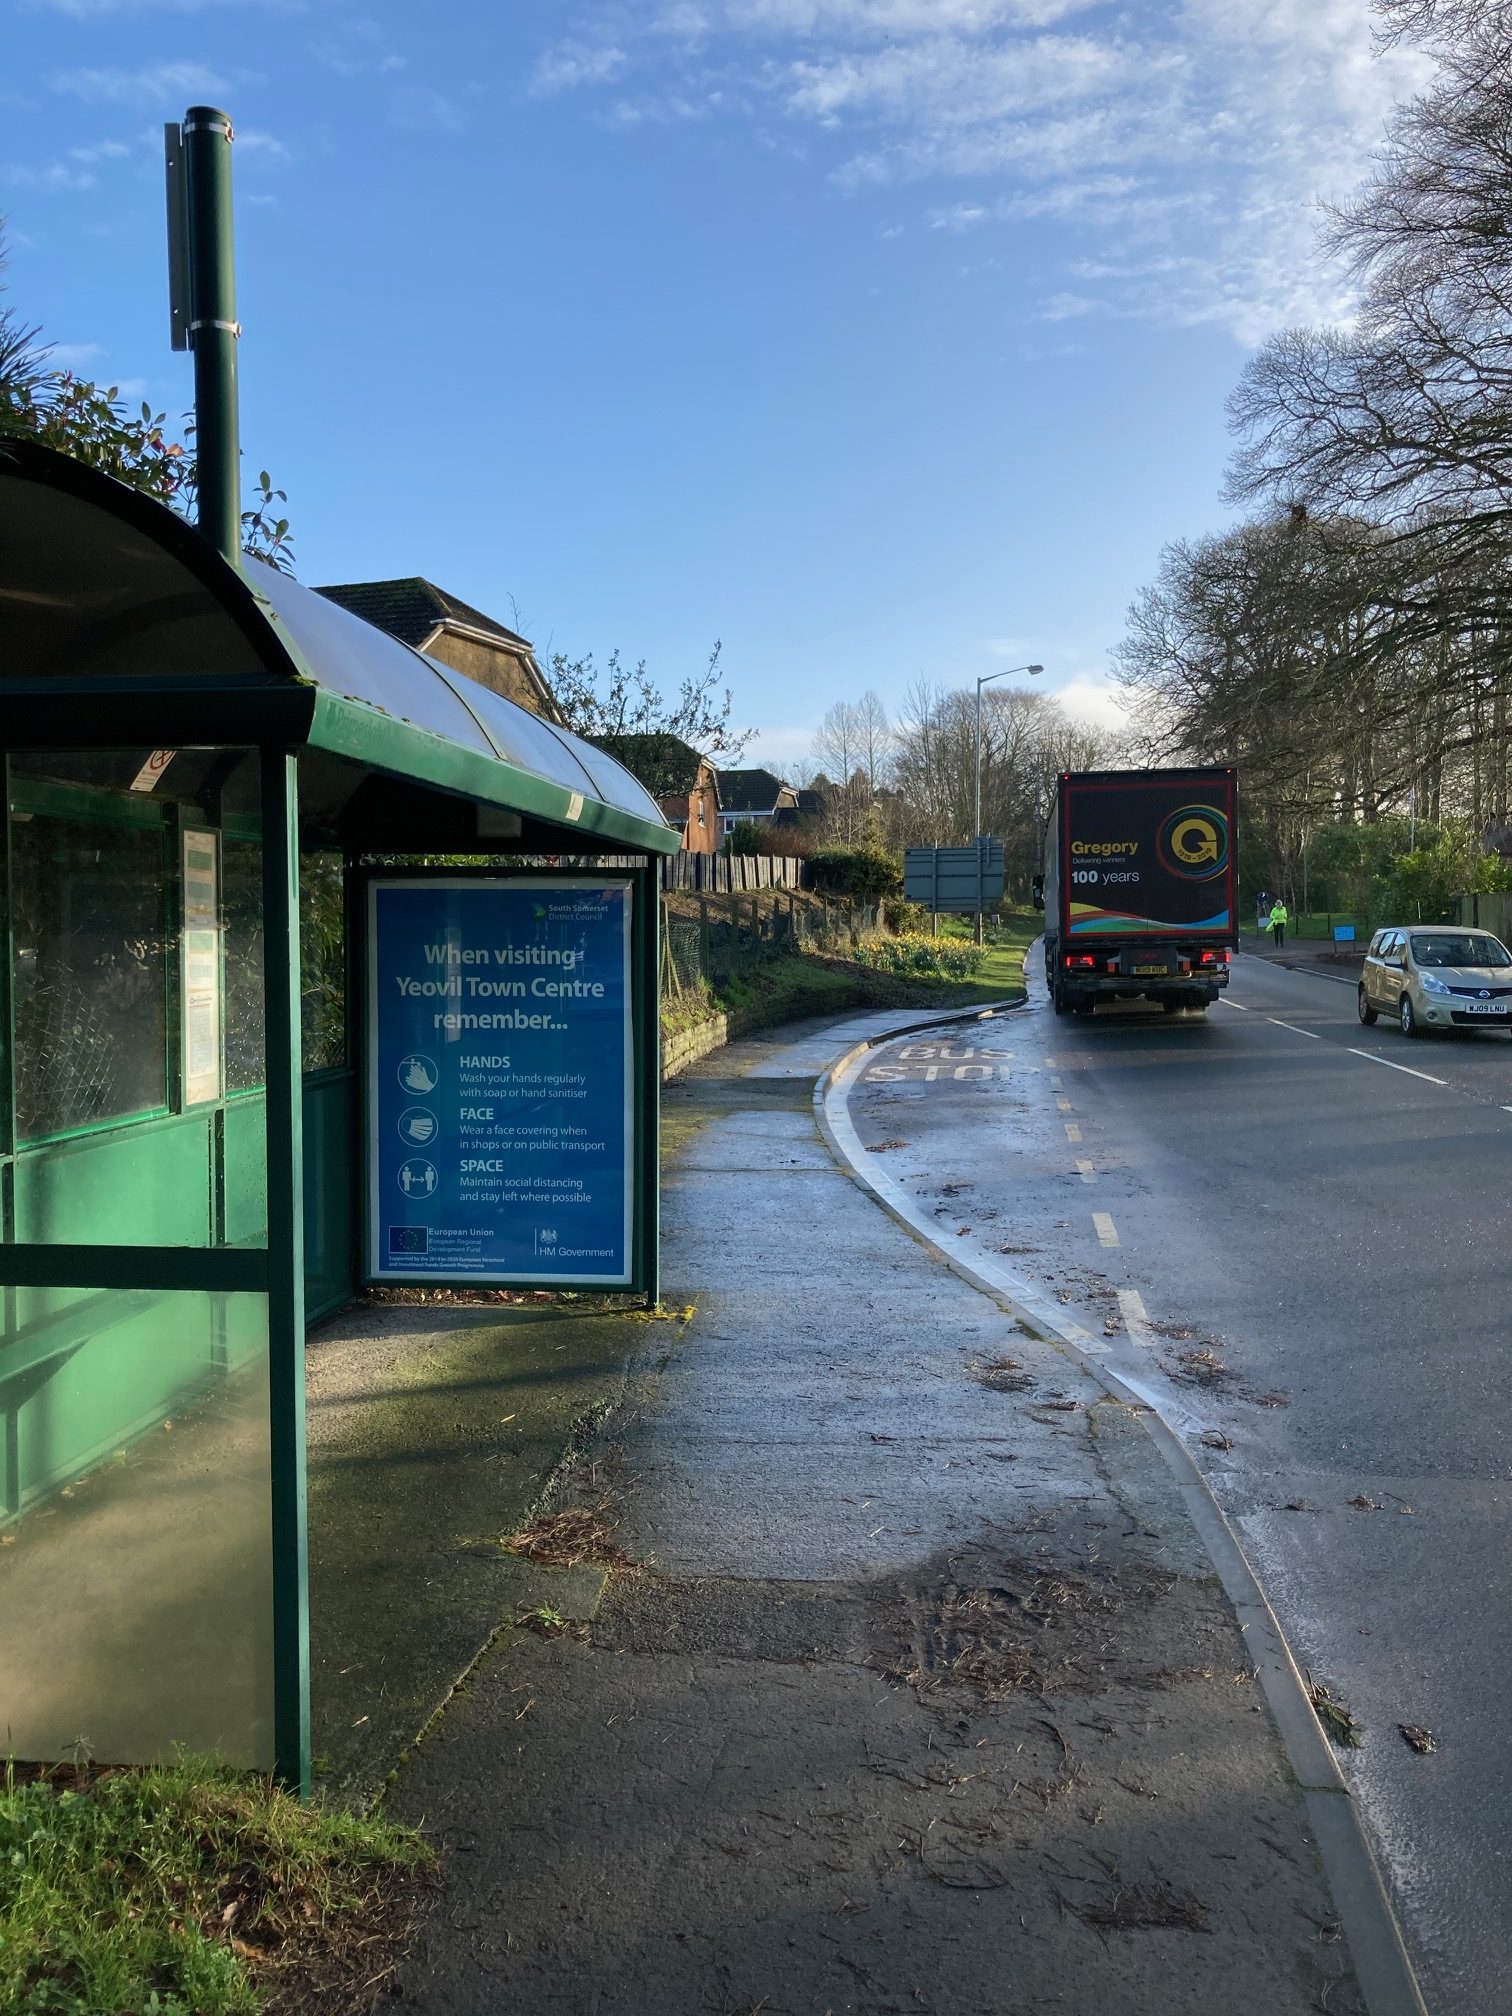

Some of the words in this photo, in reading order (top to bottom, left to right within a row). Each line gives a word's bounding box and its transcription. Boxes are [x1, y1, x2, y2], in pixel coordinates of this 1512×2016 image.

[1071, 840, 1139, 856] Gregory
[1072, 857, 1101, 865] Delivering
[1071, 870, 1098, 884] 100
[1102, 871, 1140, 886] years
[548, 904, 571, 912] South
[548, 913, 574, 921] District
[575, 913, 603, 921] Council
[424, 944, 490, 964] When
[495, 945, 576, 970] visiting
[396, 977, 462, 997] Yeovil
[466, 977, 526, 997] Town
[531, 977, 605, 998] Centre
[434, 1009, 568, 1030] remember...
[898, 1047, 1015, 1060] BUS
[460, 1056, 511, 1069] HANDS
[460, 1074, 486, 1083] Wash
[488, 1075, 510, 1085] your
[512, 1073, 542, 1083] hands
[544, 1074, 586, 1086] regularly
[460, 1088, 481, 1097] with
[483, 1090, 507, 1099] soap
[521, 1088, 546, 1098] hand
[548, 1089, 587, 1098] sanitiser
[460, 1108, 494, 1120] FACE
[460, 1125, 485, 1135] Wear
[486, 1127, 493, 1135] a
[494, 1125, 515, 1135] face
[516, 1126, 558, 1137] covering
[560, 1126, 587, 1135] when
[460, 1140, 469, 1149] in
[471, 1140, 500, 1151] shops
[502, 1141, 513, 1149] or
[529, 1140, 559, 1151] public
[561, 1141, 605, 1152] transport
[460, 1159, 504, 1172] SPACE
[460, 1177, 502, 1187] Maintain
[505, 1177, 531, 1187] social
[533, 1178, 583, 1190] distancing
[460, 1191, 479, 1201] and
[480, 1192, 500, 1203] stay
[502, 1191, 518, 1201] left
[519, 1192, 550, 1202] where
[552, 1193, 592, 1203] possible
[428, 1228, 468, 1237] European
[469, 1228, 494, 1236] Union
[539, 1247, 556, 1256] HM
[558, 1247, 614, 1257] Government
